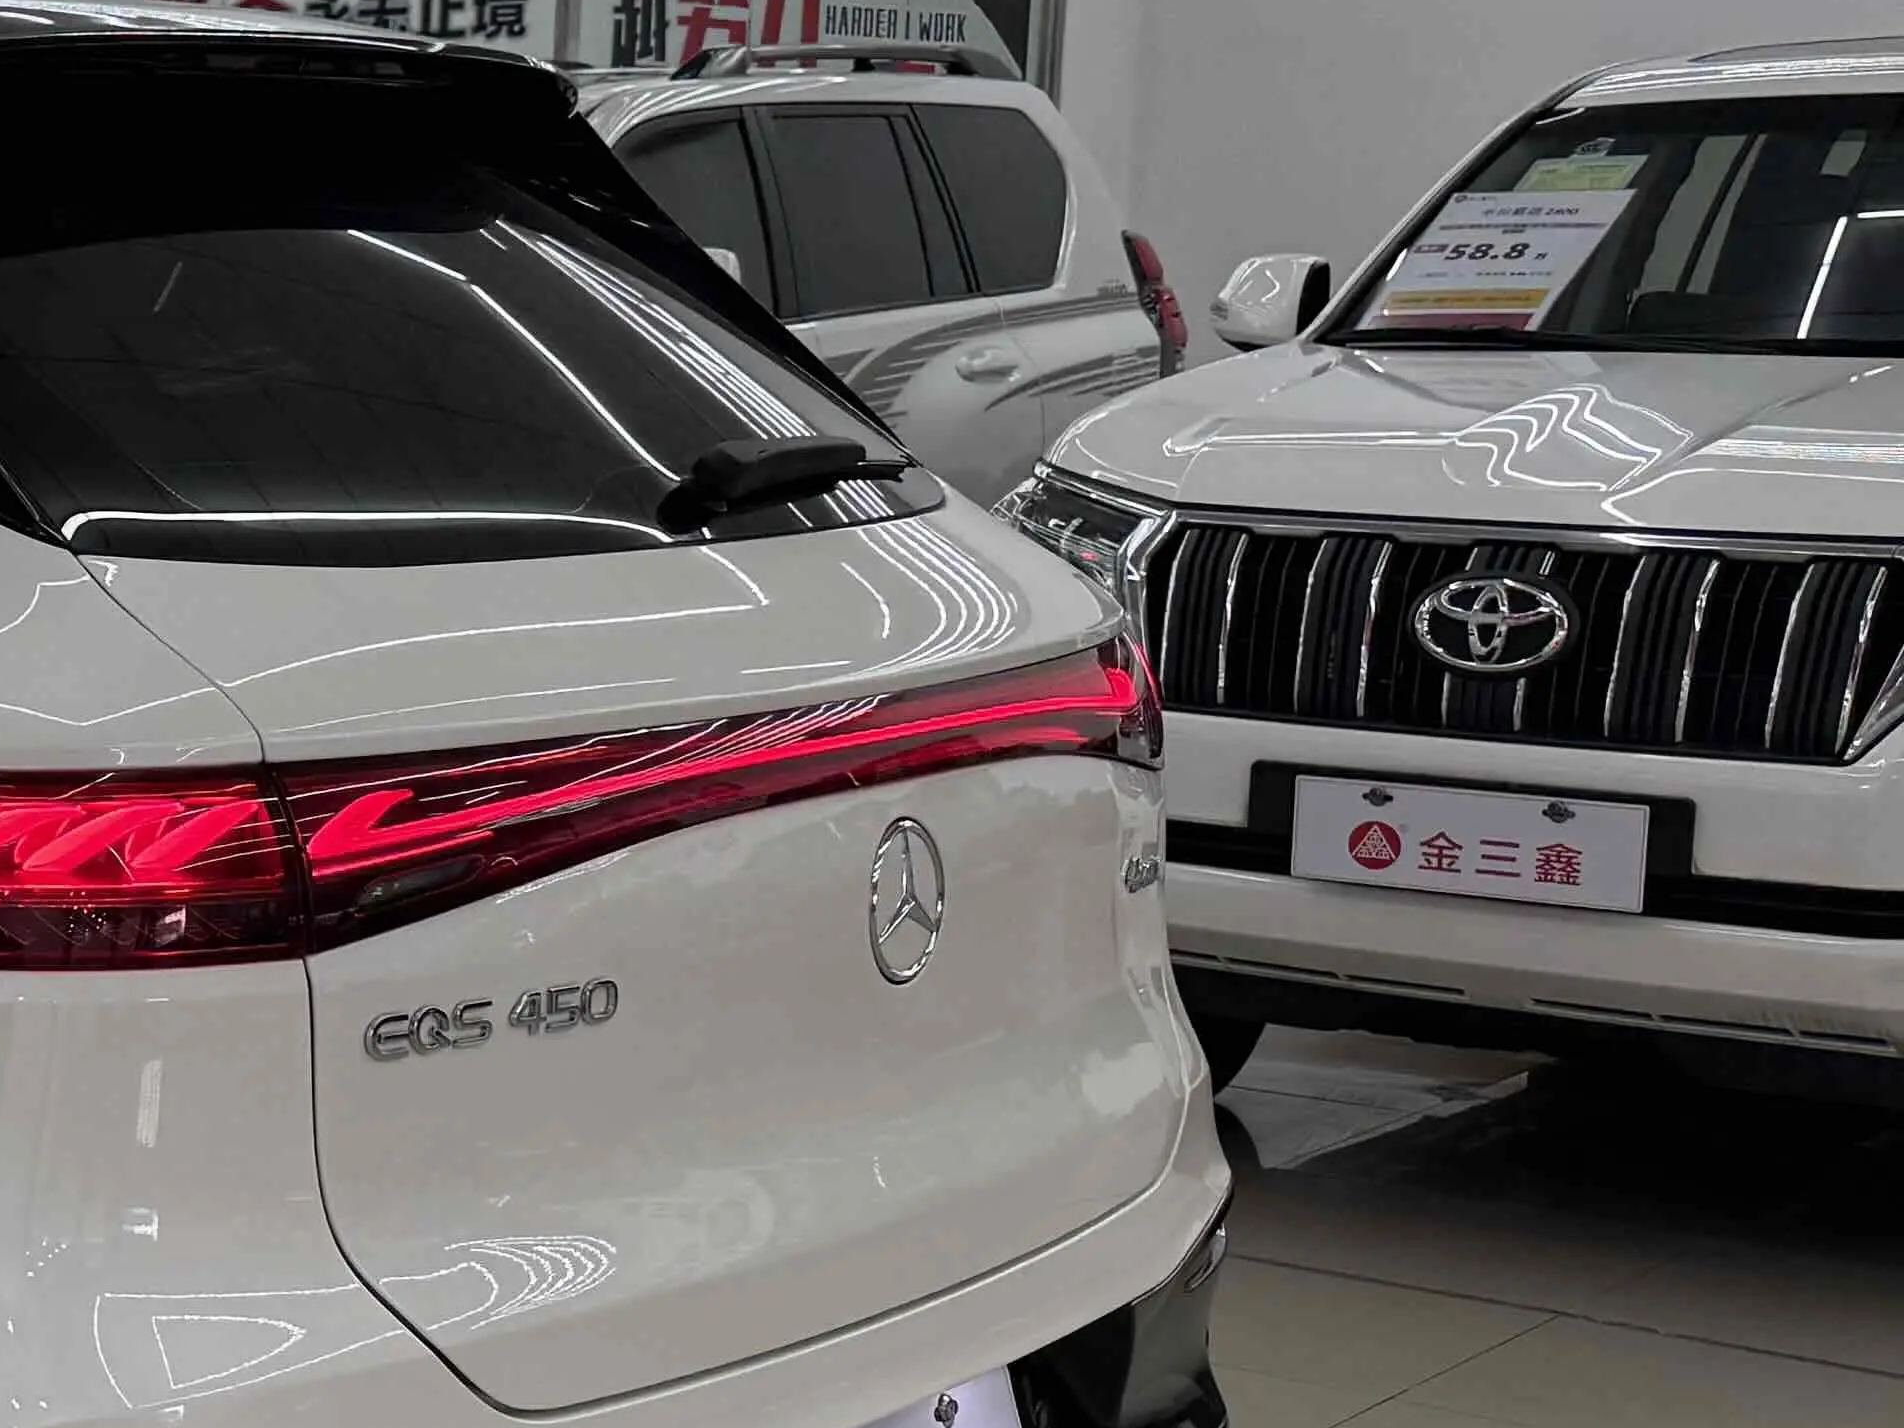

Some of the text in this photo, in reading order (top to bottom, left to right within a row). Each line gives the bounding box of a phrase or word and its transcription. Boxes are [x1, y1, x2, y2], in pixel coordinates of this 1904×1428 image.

[825, 5, 898, 39] HARDER
[918, 12, 967, 44] WORK
[1444, 242, 1531, 261] 58.8
[1417, 829, 1583, 887] 金三鑫
[363, 975, 619, 1062] EQS 450
